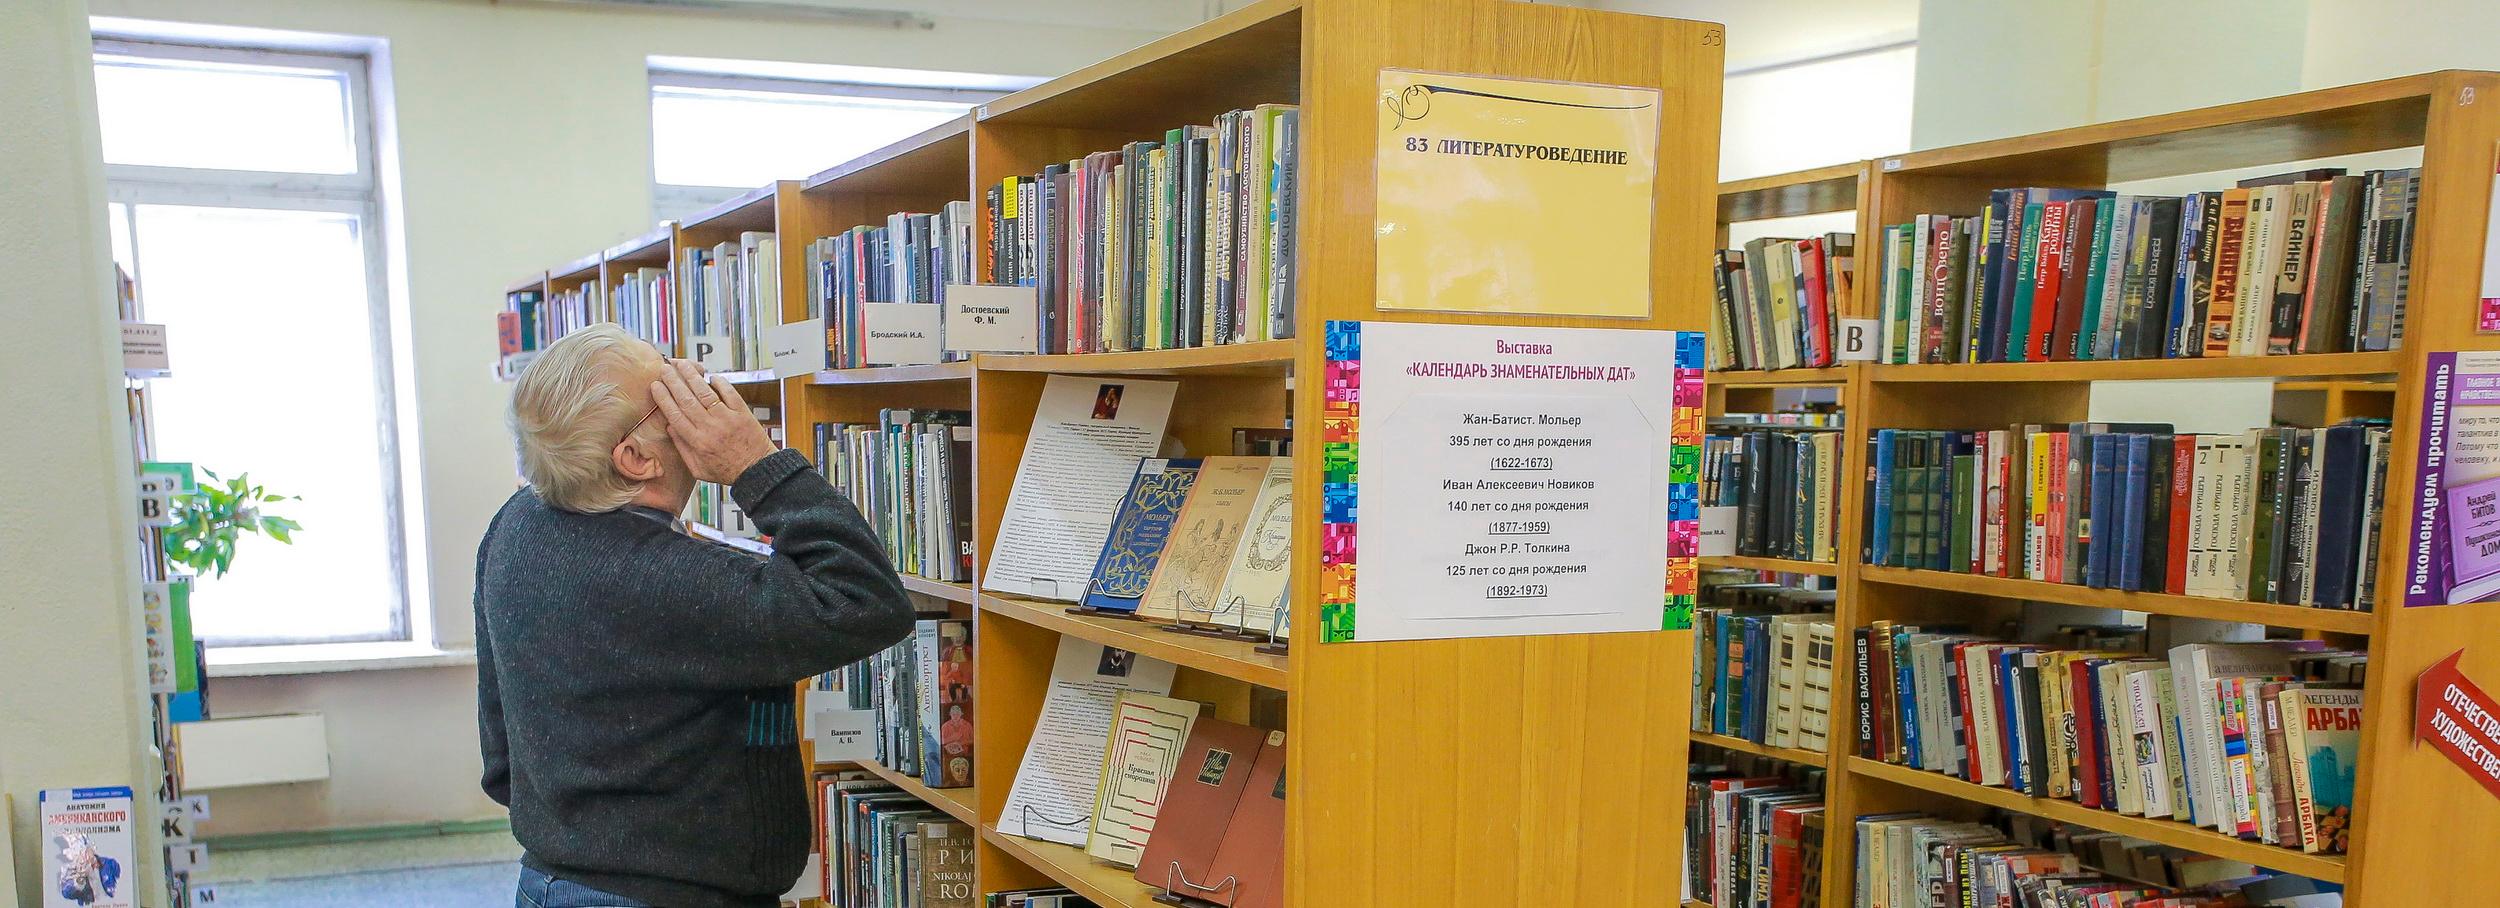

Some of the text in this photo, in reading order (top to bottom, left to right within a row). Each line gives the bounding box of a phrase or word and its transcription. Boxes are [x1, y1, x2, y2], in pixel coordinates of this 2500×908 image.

[1405, 136, 1628, 165] 83 ЛИТЕРАТУРОВЕДЕНИЕ
[1240, 125, 1250, 261] САМОУБИЙСТВО ДОСТОЕВСКОГО
[1281, 161, 1294, 257] ДОСТОЕВСКИЙ
[2040, 206, 2054, 243] Карта
[2049, 206, 2062, 254] родины
[2203, 224, 2216, 263] Вайнеры
[2285, 219, 2306, 283] ВАЙНЕР
[2214, 217, 2244, 303] ВАЙНЕРЫ
[960, 304, 1010, 315] Достоевский
[987, 316, 997, 325] М.
[871, 330, 908, 340] Бродский
[1846, 325, 1863, 353] В
[1496, 339, 1553, 355] Выставка
[1406, 361, 1636, 383] «КАЛЕНДАРЬ ЗНАМЕНАТЕЛЬНЫХ ДАТ»
[1463, 413, 1582, 427] Жан-Батист. Мольер
[1449, 435, 1592, 449] 395 лет со дня рождения
[1490, 457, 1553, 470] (1622-1673)
[2199, 451, 2207, 465] 2
[2219, 450, 2224, 463] 1
[1443, 478, 1595, 490] Иван Алексеевич Новиков
[2410, 364, 2450, 595] Рекомендуем прочитать
[1448, 500, 1589, 513] 140 лет со дня рождения
[1488, 521, 1551, 535] (1877-1959)
[2193, 513, 2202, 550] ГОСПОДА
[2210, 513, 2220, 549] ГОСПОДА
[2229, 513, 2238, 550] ГОСПОДА
[1464, 542, 1570, 556] Джон Р.Р. Толкина
[1446, 564, 1587, 577] 125 лет со дня рождения
[1486, 584, 1548, 599] (1892-1973)
[1857, 638, 1871, 740] БОРИС ВАСИЛЬЕВ
[2304, 693, 2359, 706] ЛЕГЕНДЫ
[2134, 679, 2145, 728] БУЛАТОВА
[2307, 707, 2362, 731] АРБА
[2300, 797, 2315, 845] АРБАТА
[200, 888, 215, 903] М
